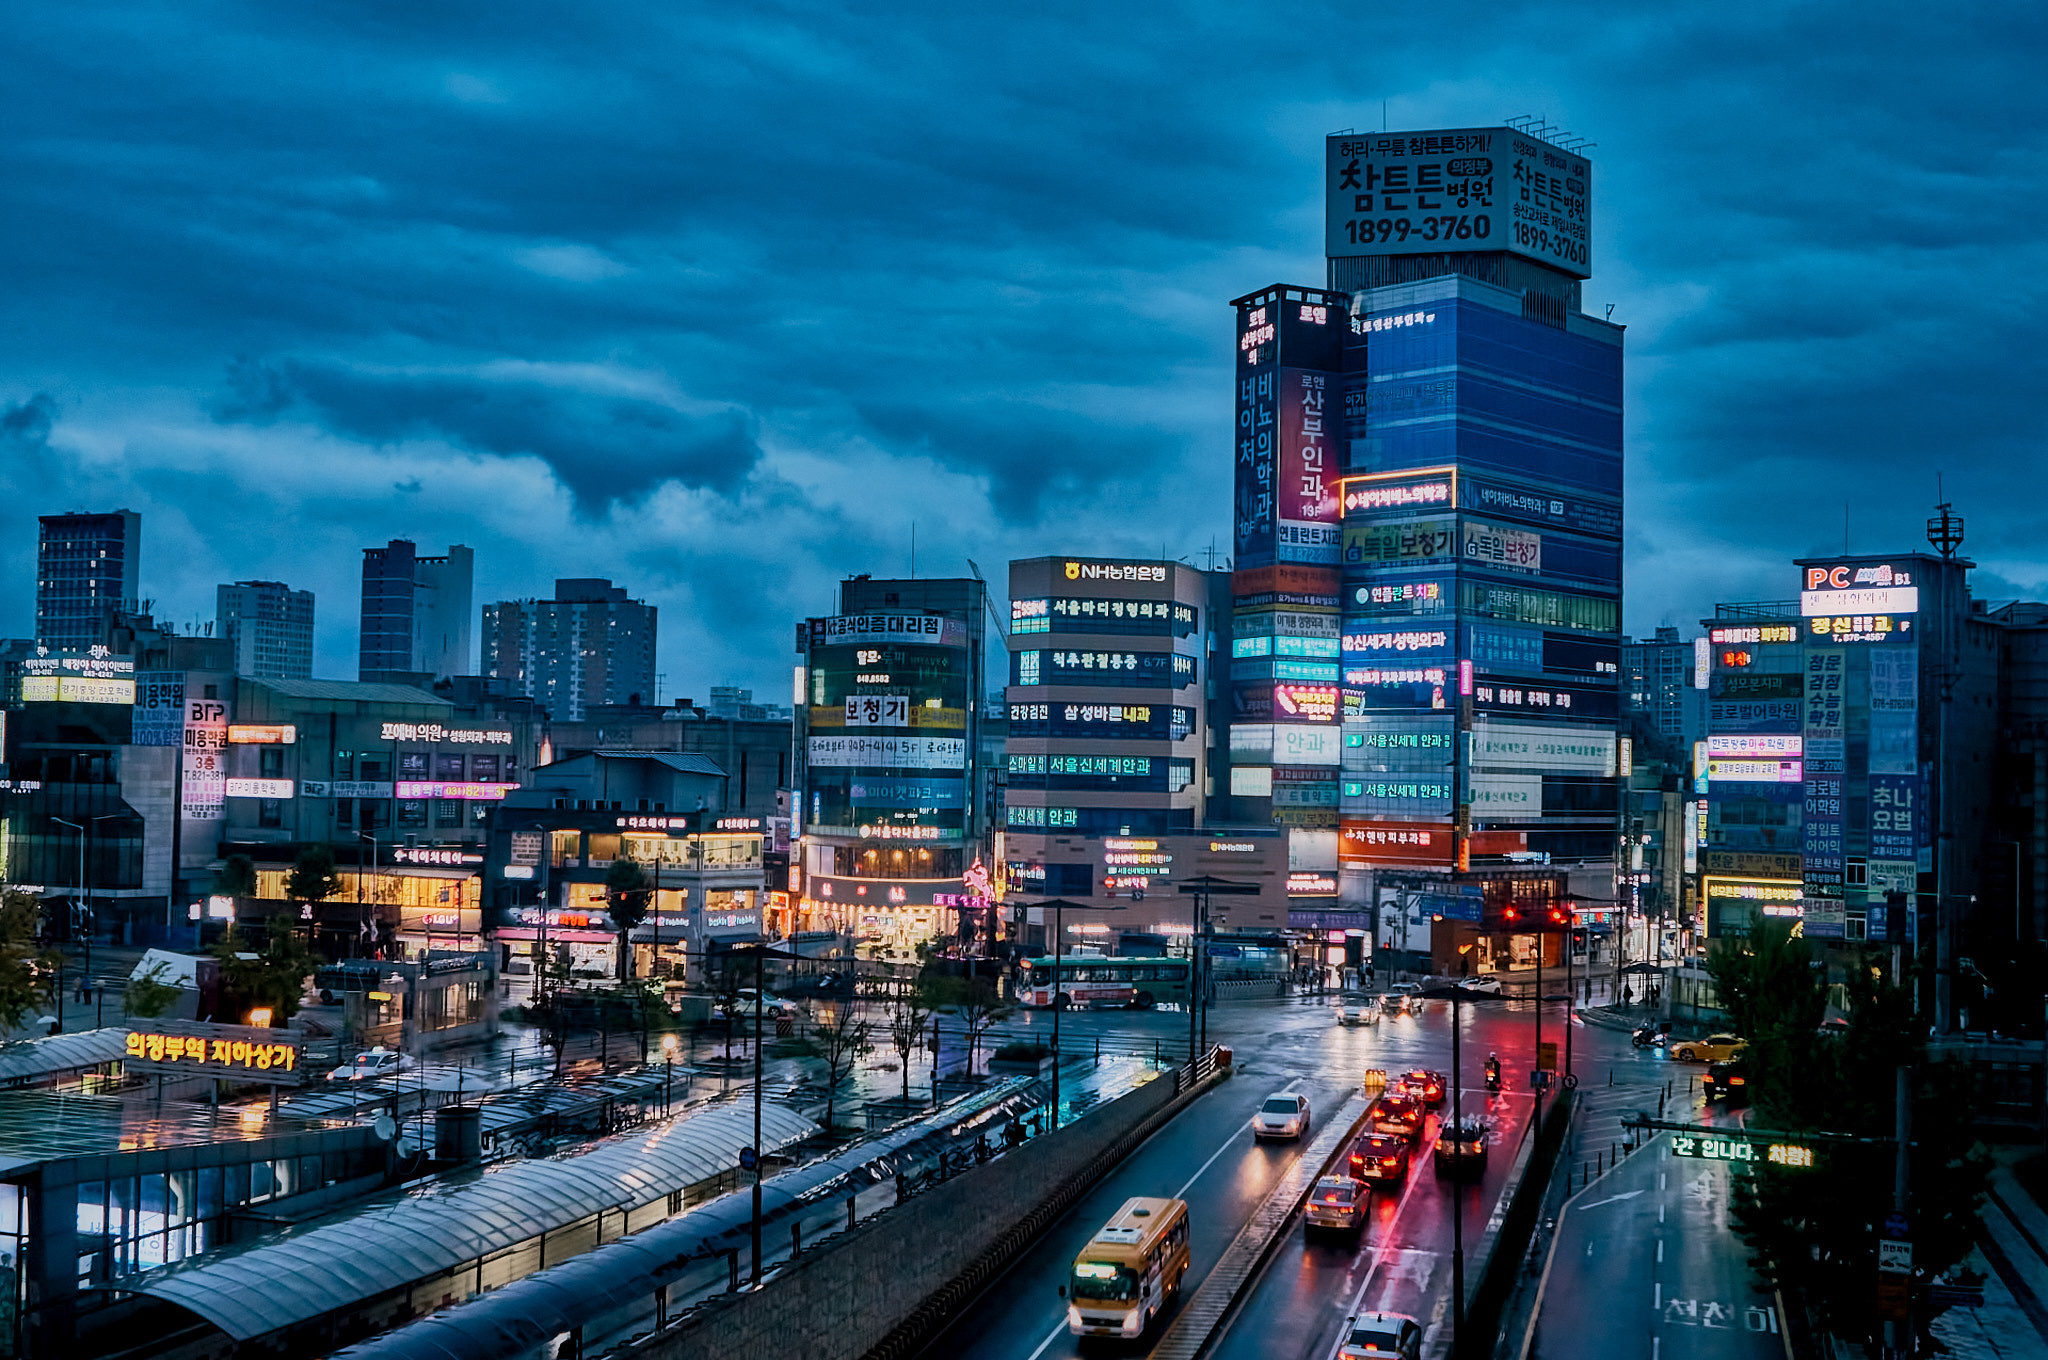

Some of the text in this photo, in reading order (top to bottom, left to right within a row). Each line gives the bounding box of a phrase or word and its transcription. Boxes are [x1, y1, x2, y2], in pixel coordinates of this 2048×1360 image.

[1340, 134, 1492, 158] 허리·무릎 참튼튼하게!
[1451, 159, 1490, 175] 의정부
[1340, 158, 1444, 212] 참튼튼
[1447, 176, 1494, 208] 병원
[1513, 159, 1563, 213] 참튼튼
[1564, 195, 1585, 222] 병원
[1345, 214, 1490, 244] 1899-3760
[1513, 220, 1586, 265] 1899-3760
[1240, 371, 1273, 521] 네이처 비뇨의학과
[1300, 390, 1324, 502] 산부인과
[1302, 504, 1322, 517] 13F
[1280, 525, 1342, 545] 연플란트치과
[1364, 531, 1454, 559] 독일보청기
[1479, 535, 1537, 564] 독일보청기
[1081, 564, 1166, 582] NH농협은행
[1808, 566, 1850, 590] PC
[1894, 573, 1911, 586] B1
[1371, 582, 1439, 602] 연플란트 치과
[1354, 631, 1446, 651] 신세계 성형외과
[1760, 627, 1790, 642] 피부과
[1053, 652, 1138, 670] 척추관절통증
[1809, 654, 1842, 672] 청운
[61, 684, 132, 697] 경기중앙 간호학원
[1809, 674, 1842, 691] 검정
[136, 684, 184, 709] 미용학원
[1809, 692, 1842, 709] 수능
[846, 699, 906, 724] 보청기
[1010, 704, 1151, 723] 건강검진 삼성바른내과
[1710, 703, 1797, 720] 글로벌어학원
[1808, 710, 1842, 728] 학원
[185, 729, 228, 748] 미용학원
[380, 723, 442, 742] 포에버의원
[1366, 735, 1442, 748] 서울신세계 안과
[1286, 732, 1326, 754] 안과
[1788, 739, 1799, 749] 5F
[196, 757, 215, 770] 3층
[1009, 756, 1151, 775] 스마일 서울신세계안과
[1366, 784, 1442, 798] 서울신세계 안과
[1804, 778, 1841, 796] 글로벌
[1873, 786, 1914, 808] 추나
[1804, 798, 1841, 816] 어학원
[1018, 808, 1078, 826] 신세계 안과
[1873, 810, 1913, 831] 요법
[1355, 830, 1419, 845] 차앤박피부과
[1775, 857, 1800, 872] 학원
[126, 1032, 295, 1071] 의정부역 지하상가
[1664, 1299, 1778, 1334] 천천히
